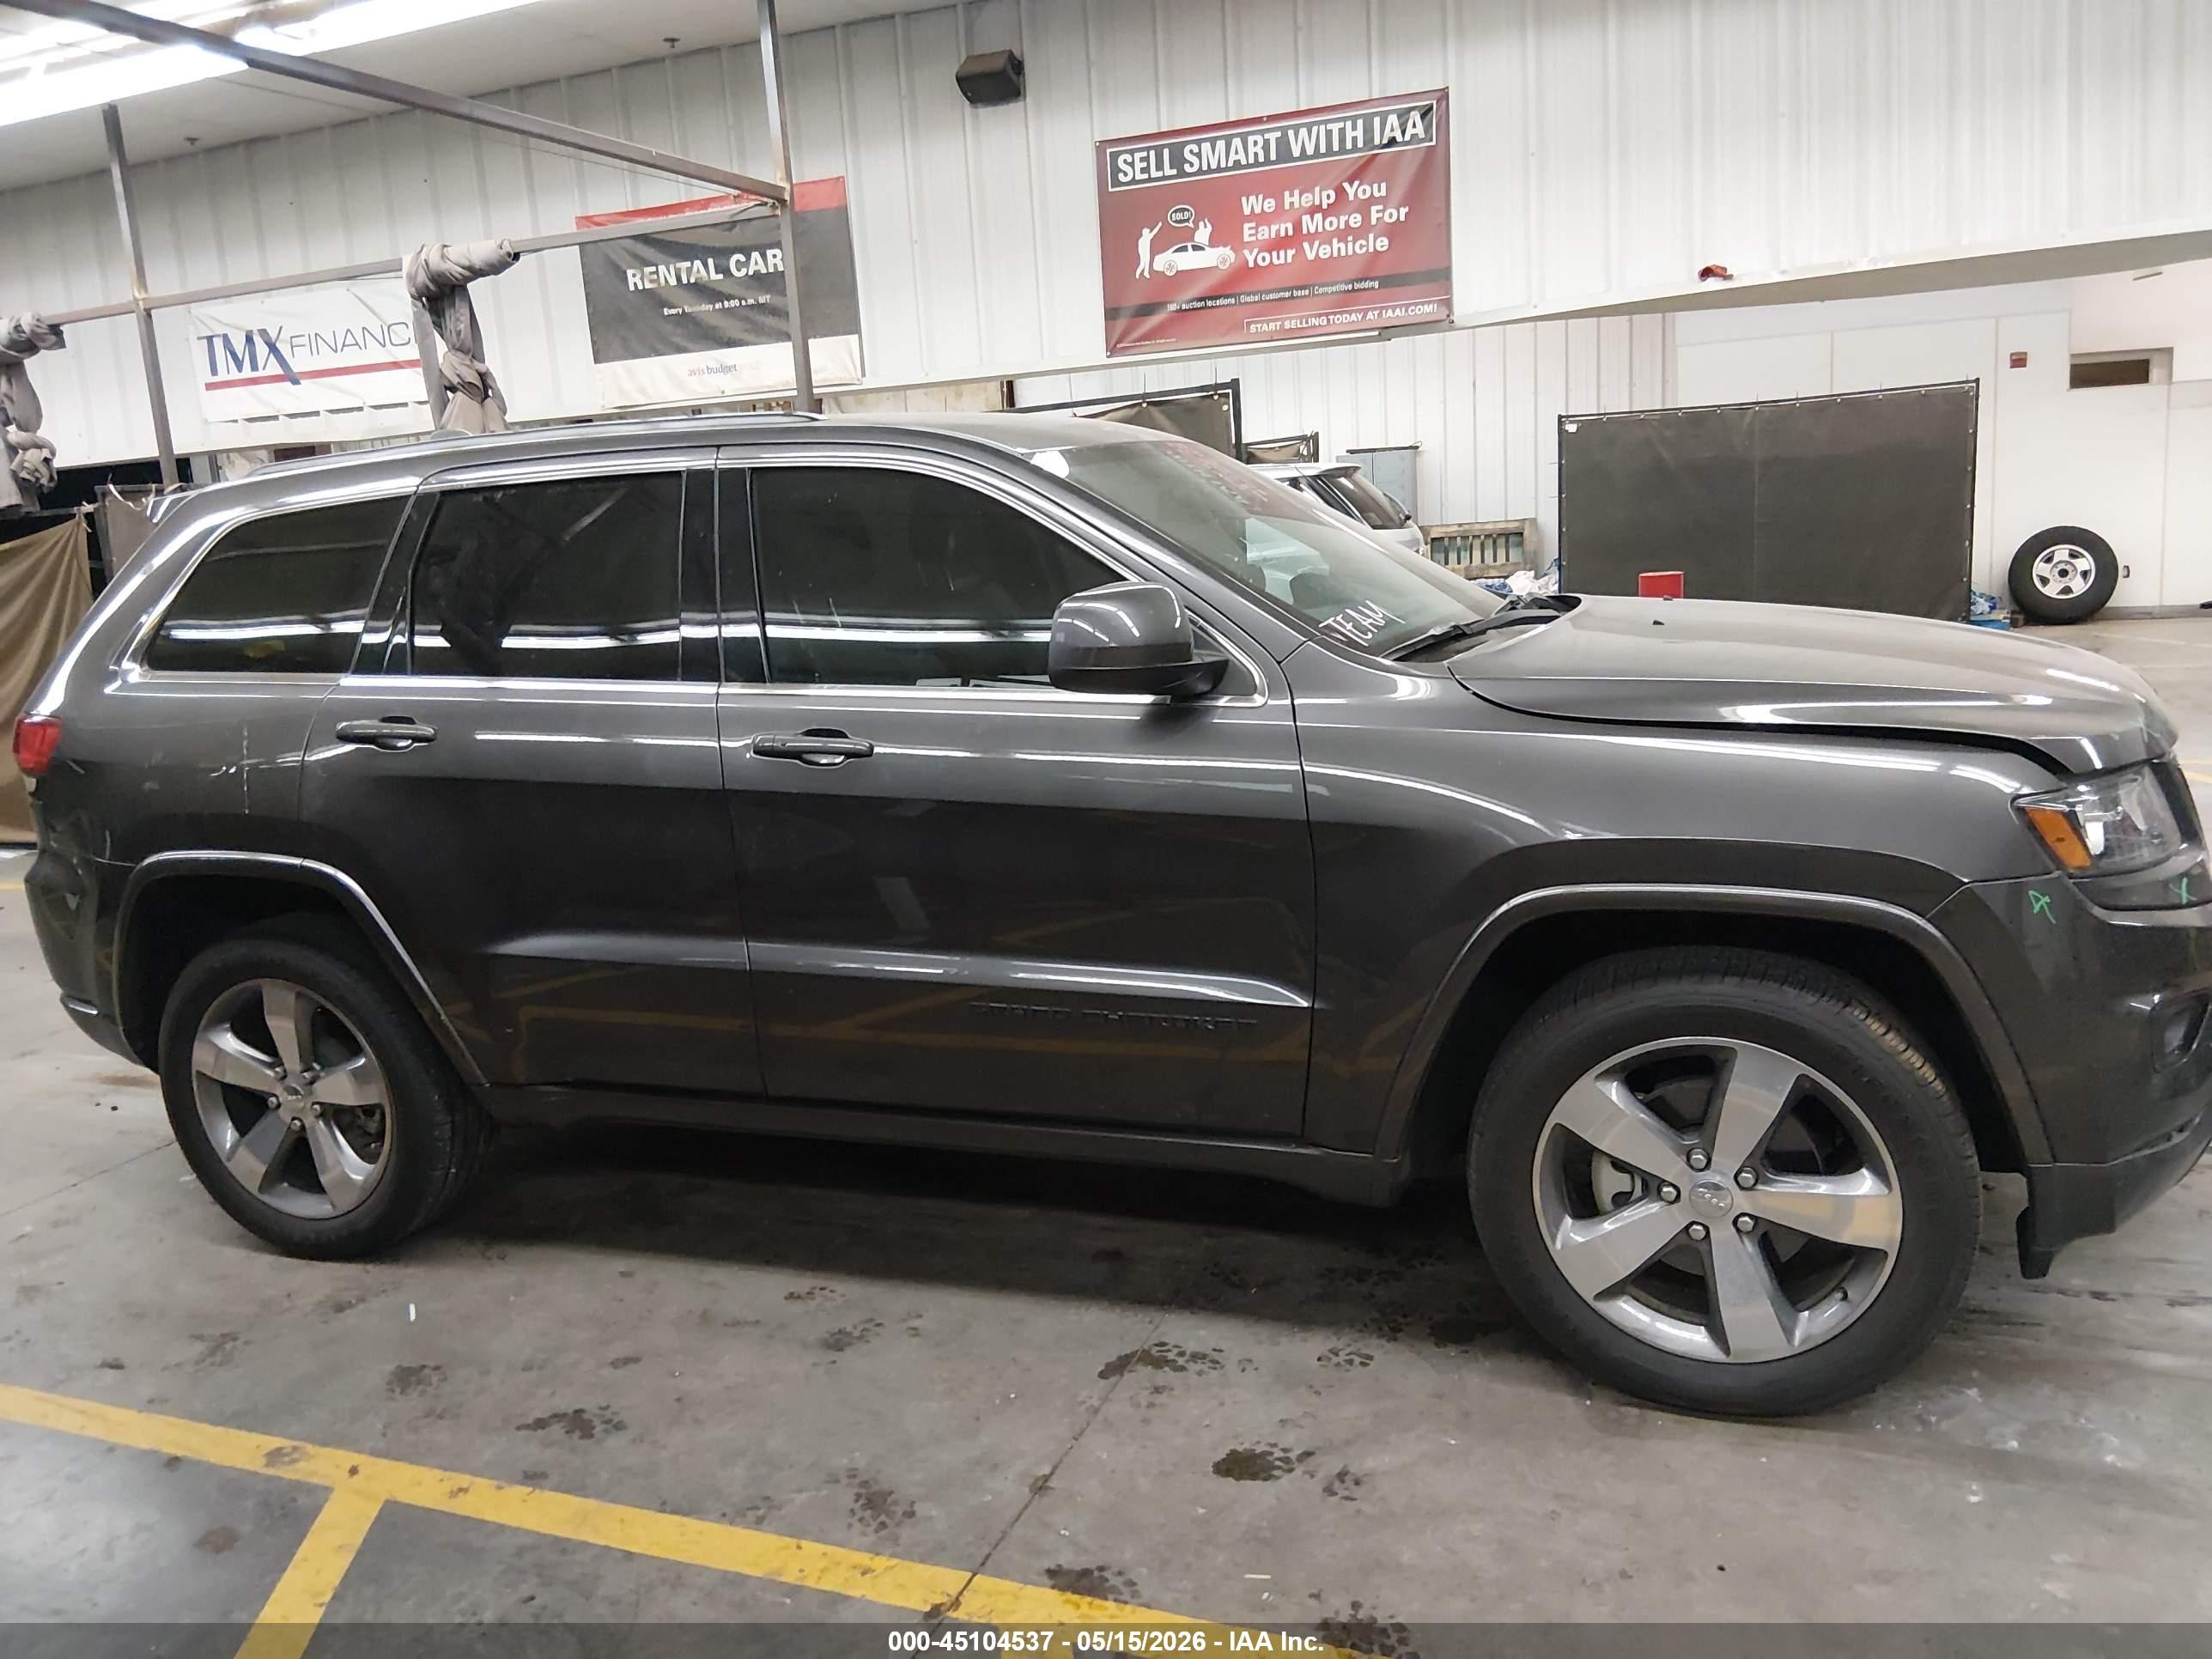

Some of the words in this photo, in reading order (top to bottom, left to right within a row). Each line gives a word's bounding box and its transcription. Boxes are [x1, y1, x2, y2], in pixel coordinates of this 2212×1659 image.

[1117, 148, 1177, 183] SELL
[1183, 131, 1282, 173] SMART
[1288, 118, 1364, 158] WITH
[1374, 111, 1425, 146] IAA
[1241, 194, 1276, 216] We
[1284, 185, 1336, 210] Help
[1342, 180, 1387, 201] You
[1243, 222, 1294, 242] Earn
[1301, 213, 1363, 234] More
[1370, 204, 1409, 226] For
[1243, 247, 1296, 268] Your
[1302, 234, 1389, 261] Vehicle
[626, 258, 724, 291] RENTAL
[729, 248, 785, 277] CAR
[684, 303, 714, 313] Tuday
[1182, 300, 1206, 309] auction
[1206, 297, 1236, 307] locations
[1240, 292, 1261, 303] Global
[1261, 290, 1292, 301] customer
[1293, 289, 1310, 297] base
[1314, 283, 1352, 295] Competitive
[1353, 280, 1379, 290] bidding
[1249, 321, 1282, 333] START
[1284, 316, 1328, 330] SELLING
[1328, 312, 1364, 325] TODAY
[1366, 310, 1379, 320] AT
[197, 325, 302, 386] TMX
[706, 363, 738, 376] budget
[1318, 599, 1406, 647] TEAM
